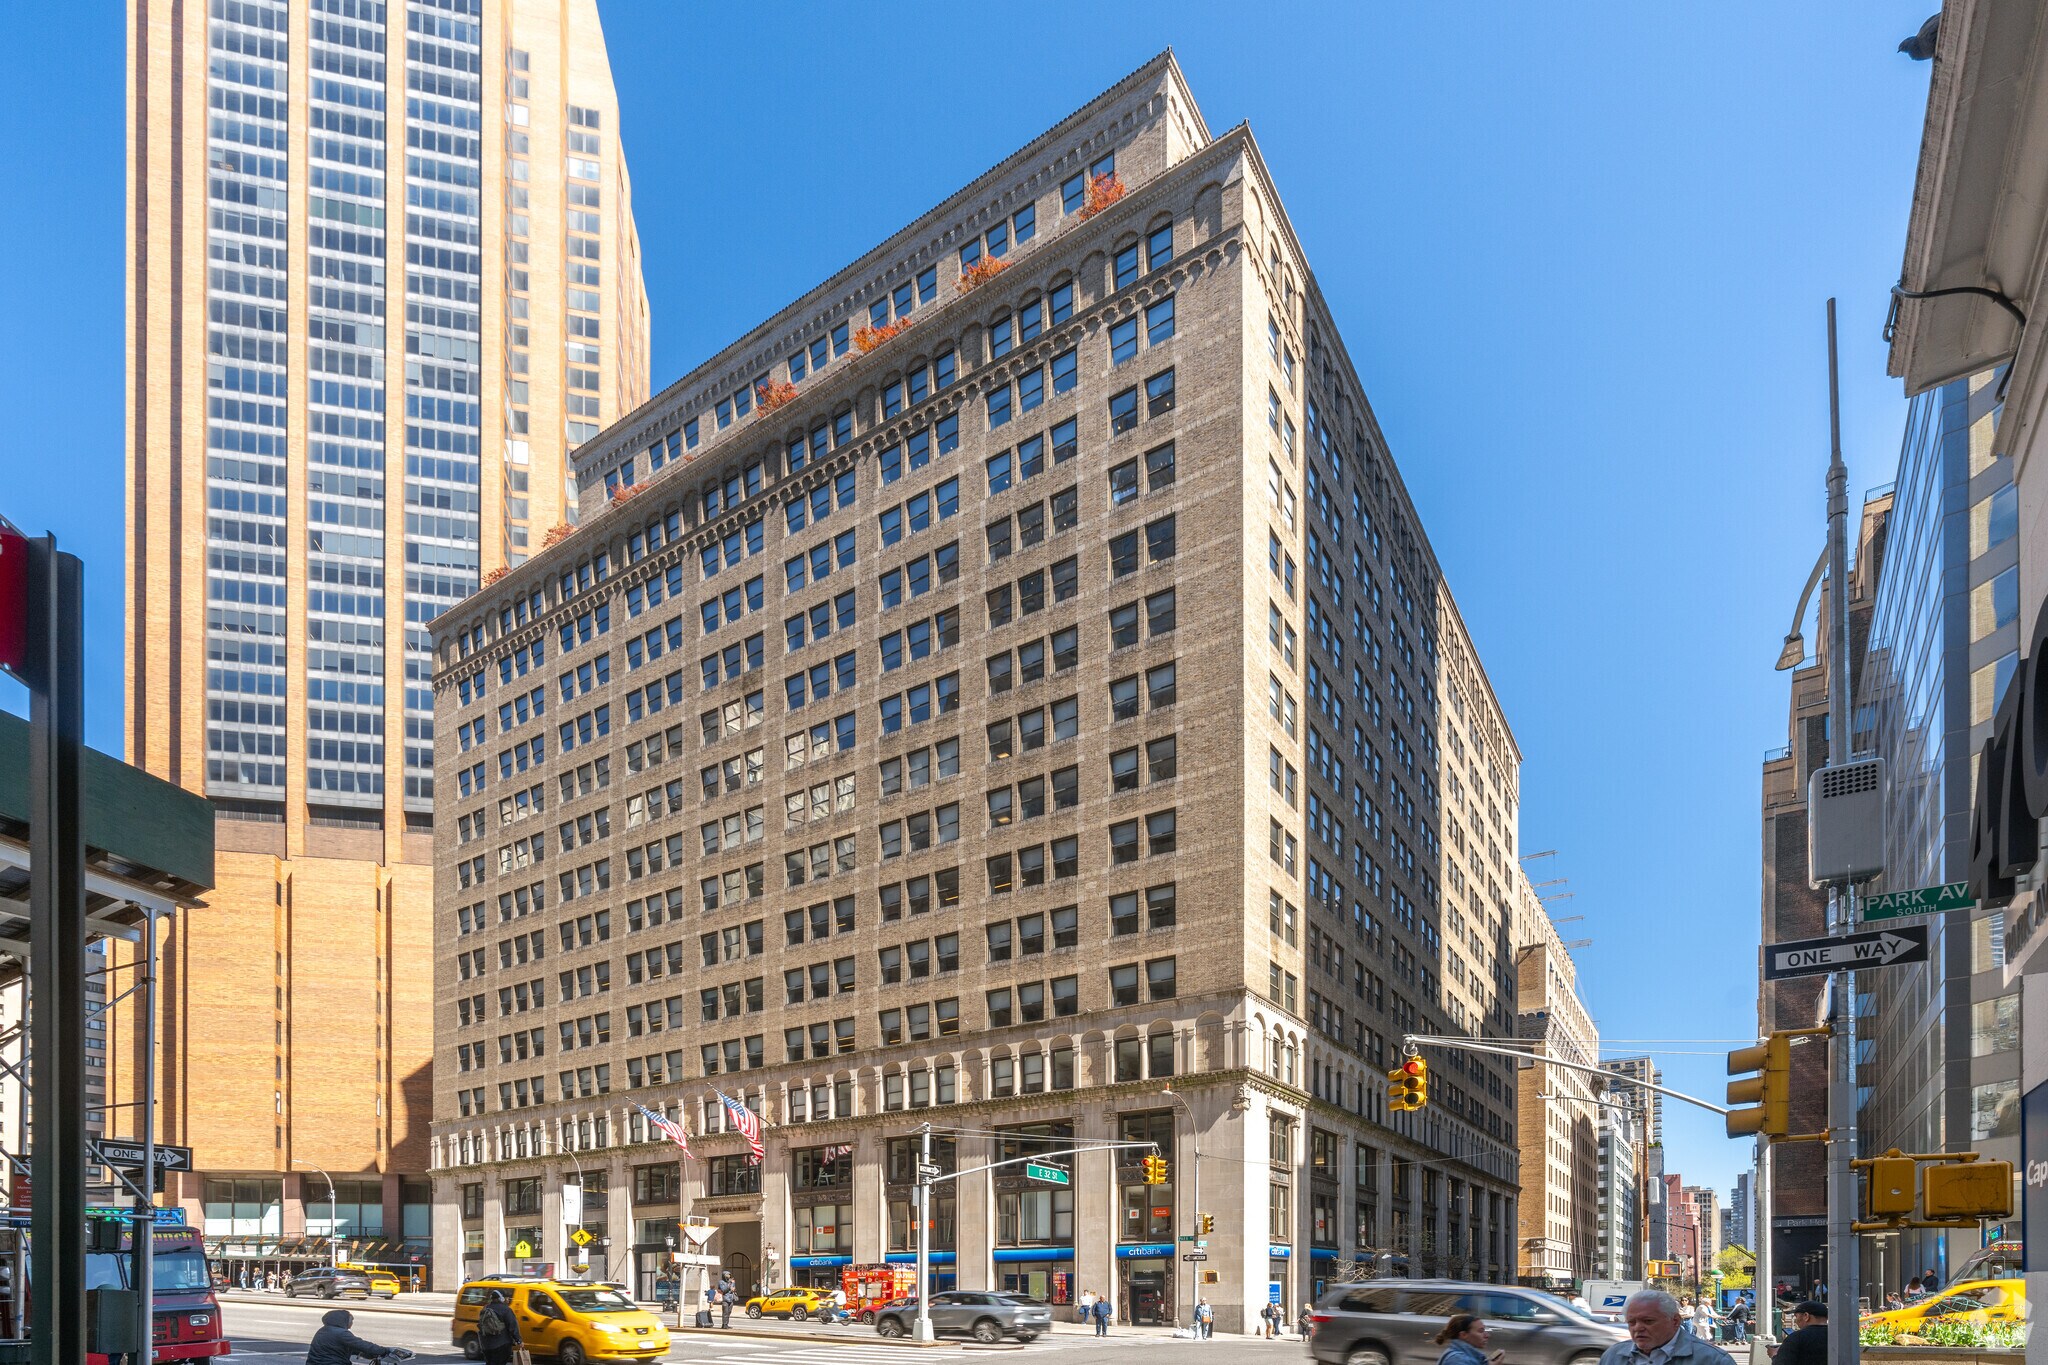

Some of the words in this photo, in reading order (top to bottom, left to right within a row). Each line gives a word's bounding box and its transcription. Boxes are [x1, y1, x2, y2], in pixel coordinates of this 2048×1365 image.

[1866, 889, 1927, 911] PARK
[1938, 881, 1969, 901] AV
[1896, 903, 1937, 917] SOUTH
[2005, 901, 2037, 965] PARK
[1787, 948, 1832, 967] ONE
[1853, 939, 1902, 959] WAY
[112, 1149, 138, 1159] ONE
[152, 1152, 176, 1163] WAY
[1039, 1169, 1043, 1177] E
[1044, 1170, 1051, 1178] 32
[1052, 1171, 1058, 1180] St
[153, 1231, 193, 1240] unch
[1128, 1247, 1162, 1256] citibank
[810, 1258, 832, 1266] citibank
